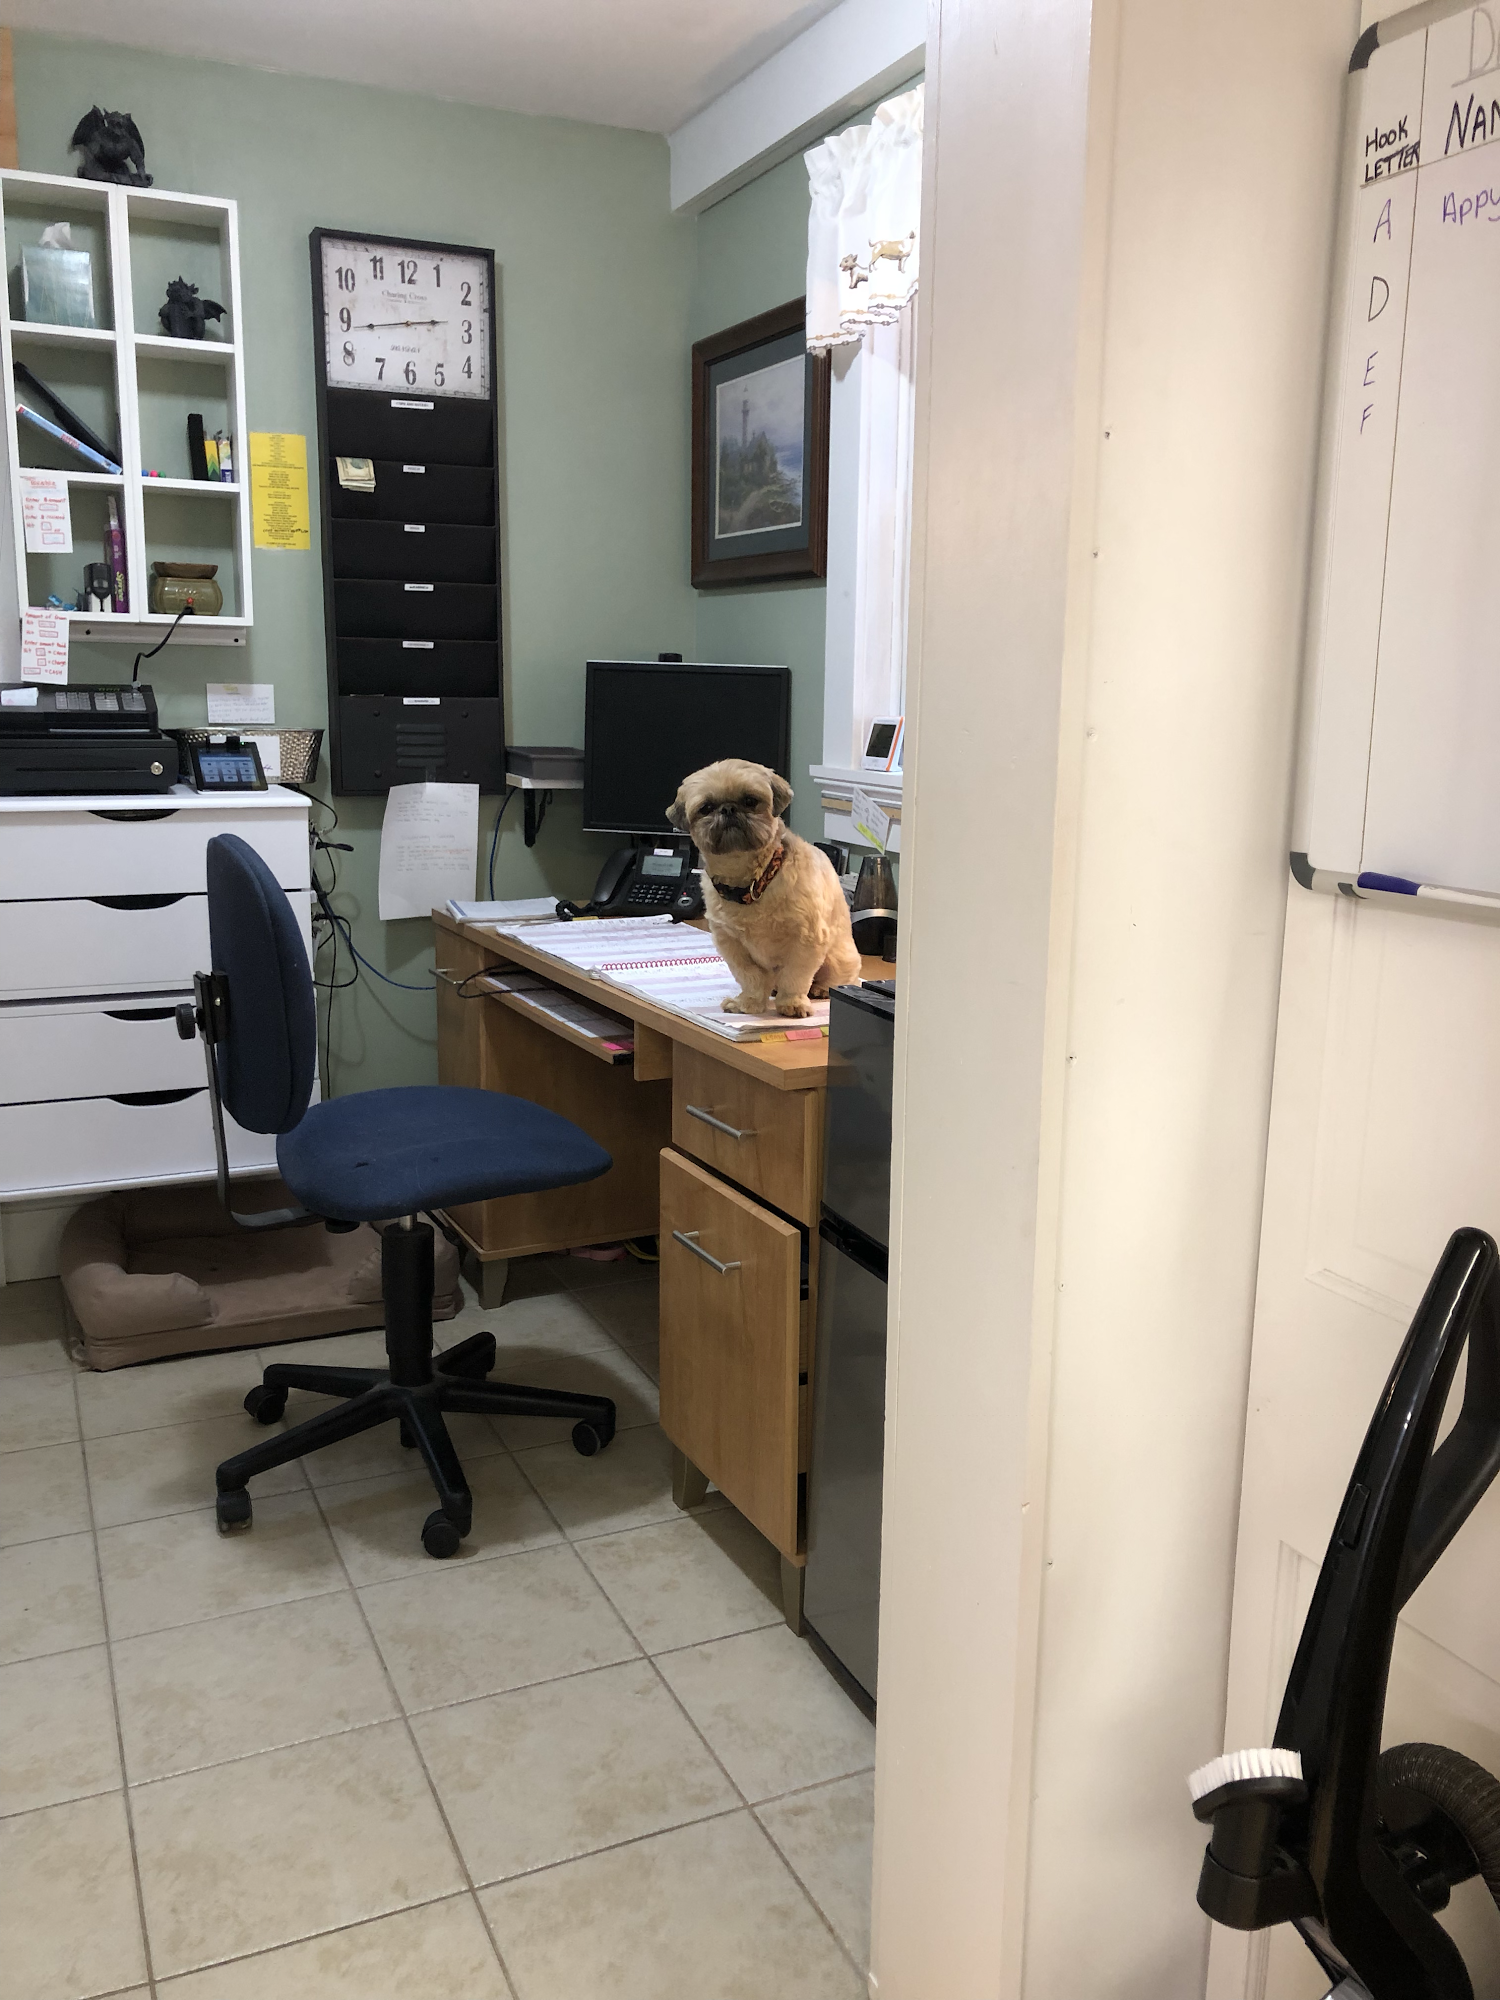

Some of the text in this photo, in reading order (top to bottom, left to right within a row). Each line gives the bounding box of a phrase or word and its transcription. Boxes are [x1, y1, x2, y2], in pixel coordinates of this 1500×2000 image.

[1469, 7, 1500, 77] D
[1365, 115, 1408, 157] HOOK
[1364, 140, 1421, 183] LETTER
[1373, 198, 1392, 243] A
[335, 266, 356, 293] 10
[369, 255, 384, 281] 11
[397, 259, 418, 285] 12
[433, 264, 441, 288] 1
[460, 281, 472, 307] 2
[1367, 276, 1390, 322] D
[339, 307, 352, 333] 9
[461, 319, 473, 345] 3
[342, 340, 356, 367] 8
[375, 357, 386, 381] 7
[403, 360, 417, 386] 6
[434, 363, 446, 387] 5
[461, 355, 473, 379] 4
[1363, 351, 1379, 387] E
[1360, 403, 1375, 435] F
